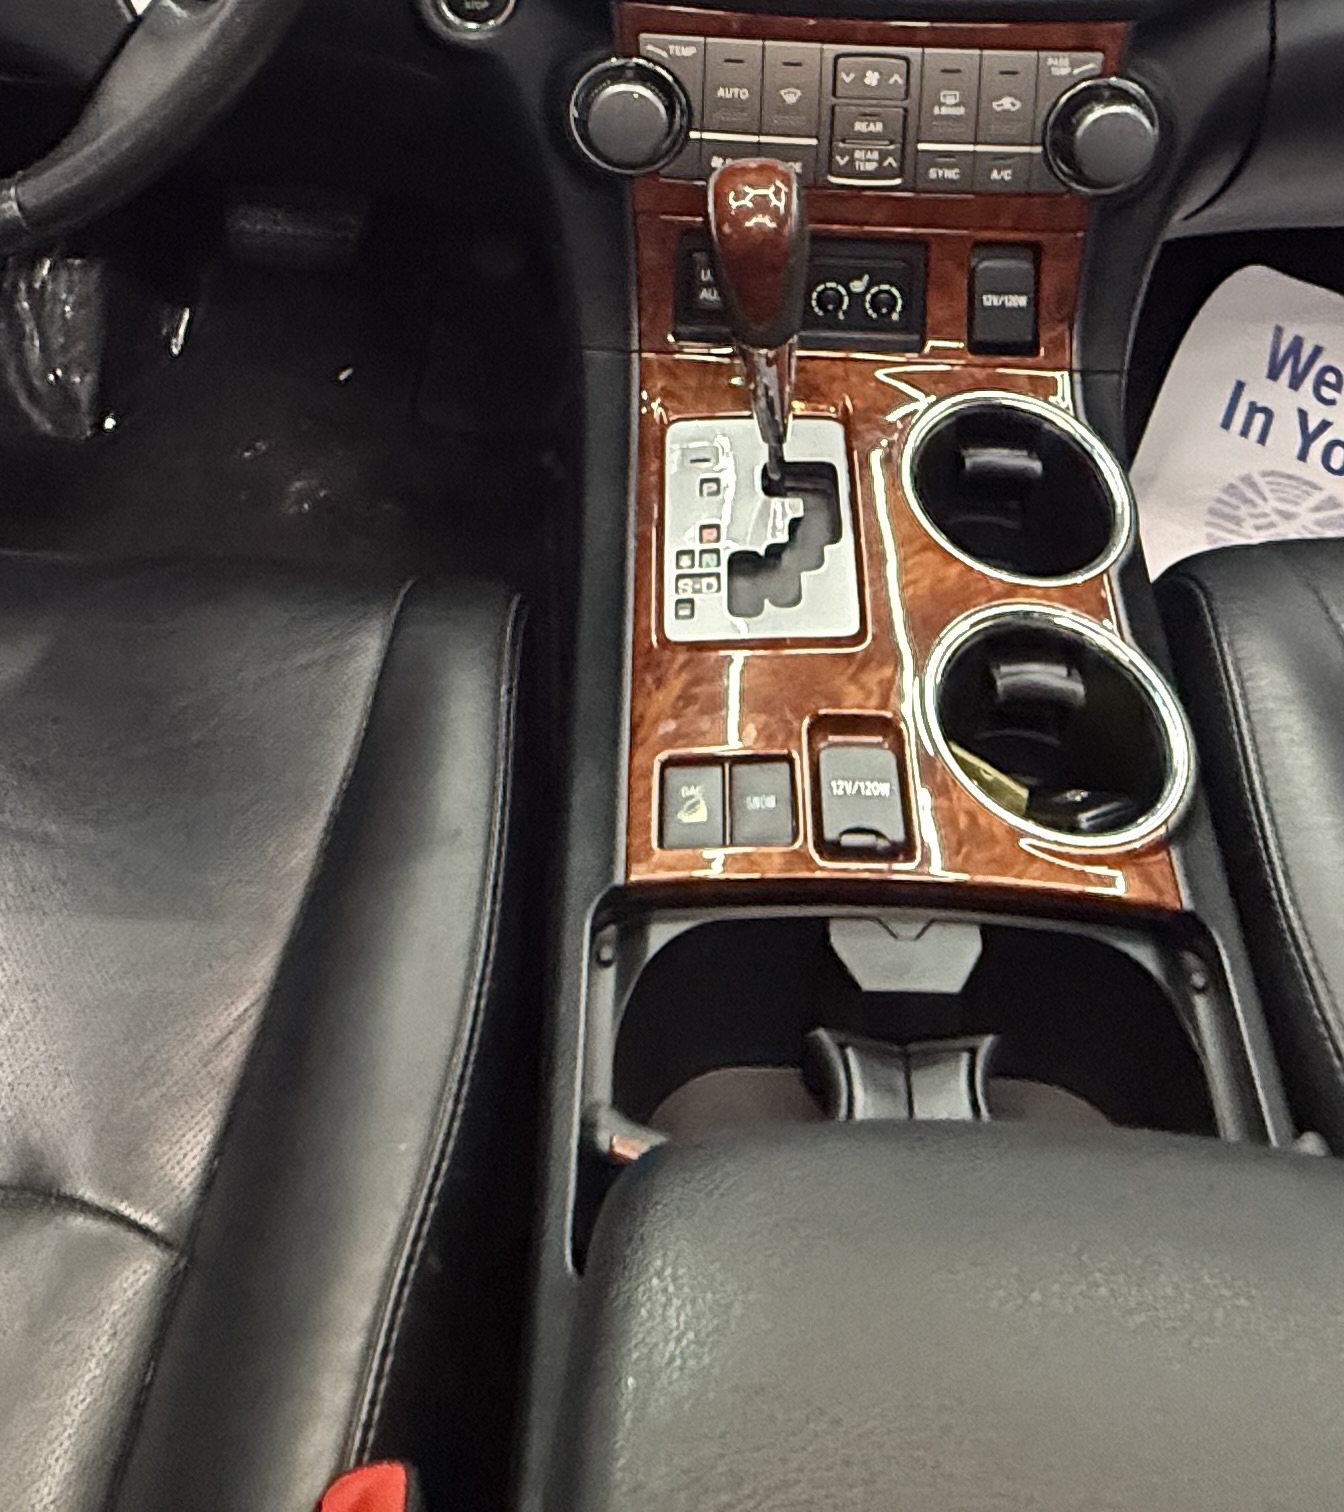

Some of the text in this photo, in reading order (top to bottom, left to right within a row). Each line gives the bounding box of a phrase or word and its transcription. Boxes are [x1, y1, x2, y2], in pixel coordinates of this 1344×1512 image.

[668, 44, 698, 58] TEMP
[716, 86, 750, 101] AUTO
[853, 120, 884, 133] REAR
[853, 149, 880, 161] REAR
[854, 160, 880, 173] TEMP
[927, 167, 961, 181] SYNC
[989, 168, 1014, 182] A/C
[1217, 378, 1276, 448] In
[829, 779, 891, 798] 12V/120W
